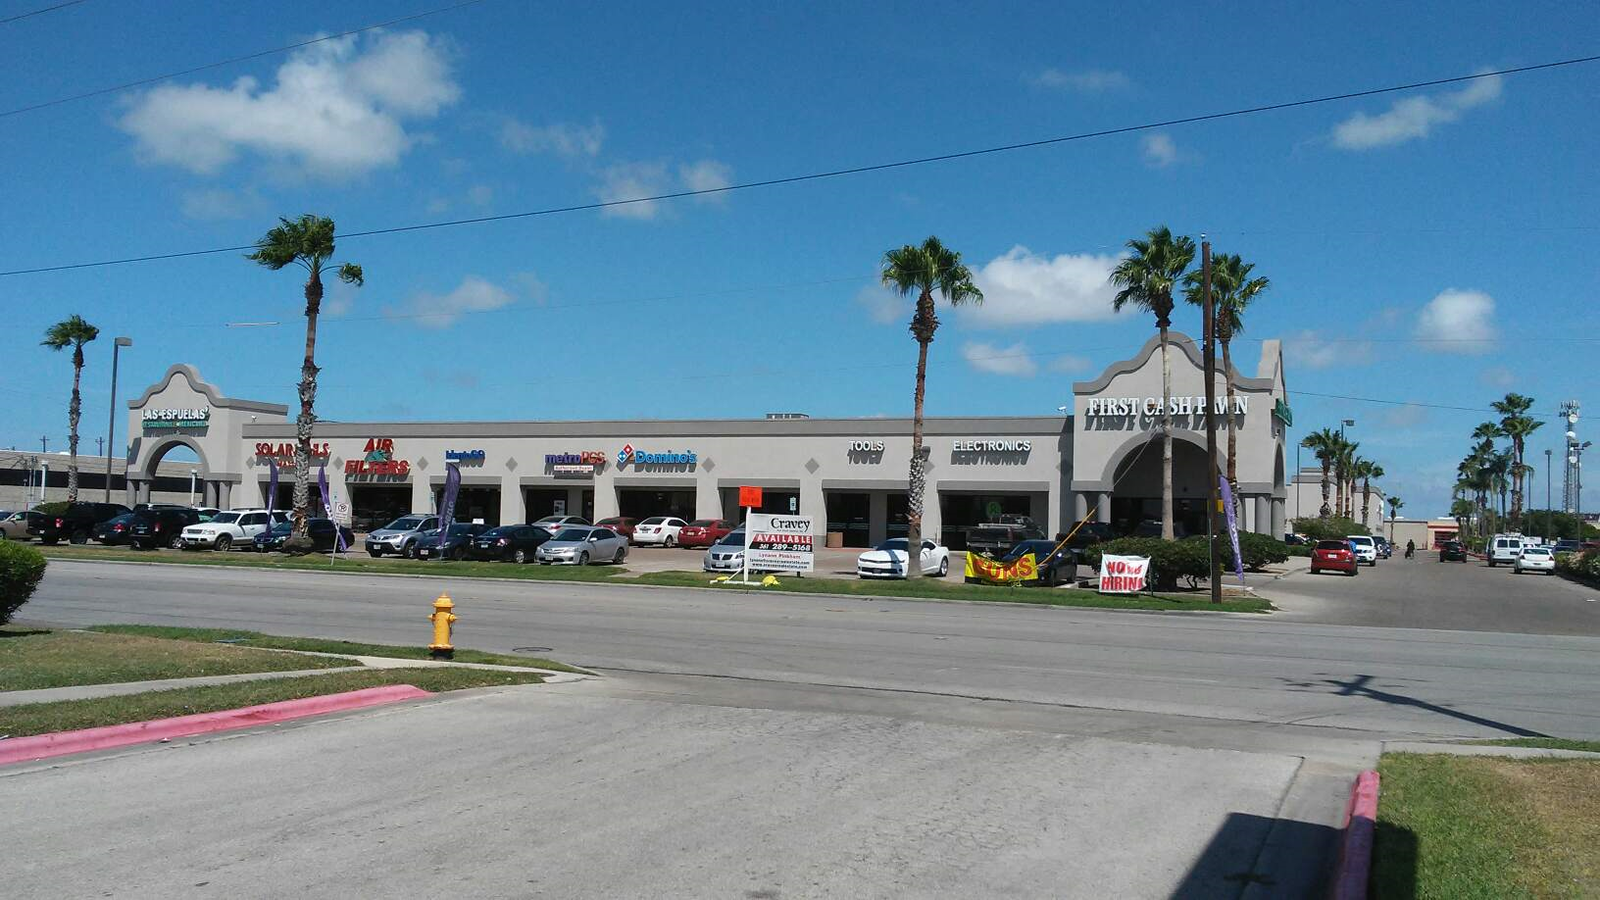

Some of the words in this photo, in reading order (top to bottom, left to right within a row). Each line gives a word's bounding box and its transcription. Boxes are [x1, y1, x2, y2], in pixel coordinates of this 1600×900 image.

[1088, 397, 1140, 416] FIRST
[1143, 397, 1192, 416] CASH
[1196, 396, 1249, 415] PWN
[255, 443, 297, 456] SOLAR
[363, 438, 394, 452] AIR
[850, 440, 884, 451] TOOLS
[953, 440, 1031, 451] ELECTRONICS
[545, 451, 606, 464] metroPCS
[634, 450, 698, 464] Domino's
[344, 460, 411, 475] FILTERS
[770, 517, 811, 533] Cravey
[757, 533, 811, 544] AVAILABLE
[772, 543, 811, 552] 289-5168
